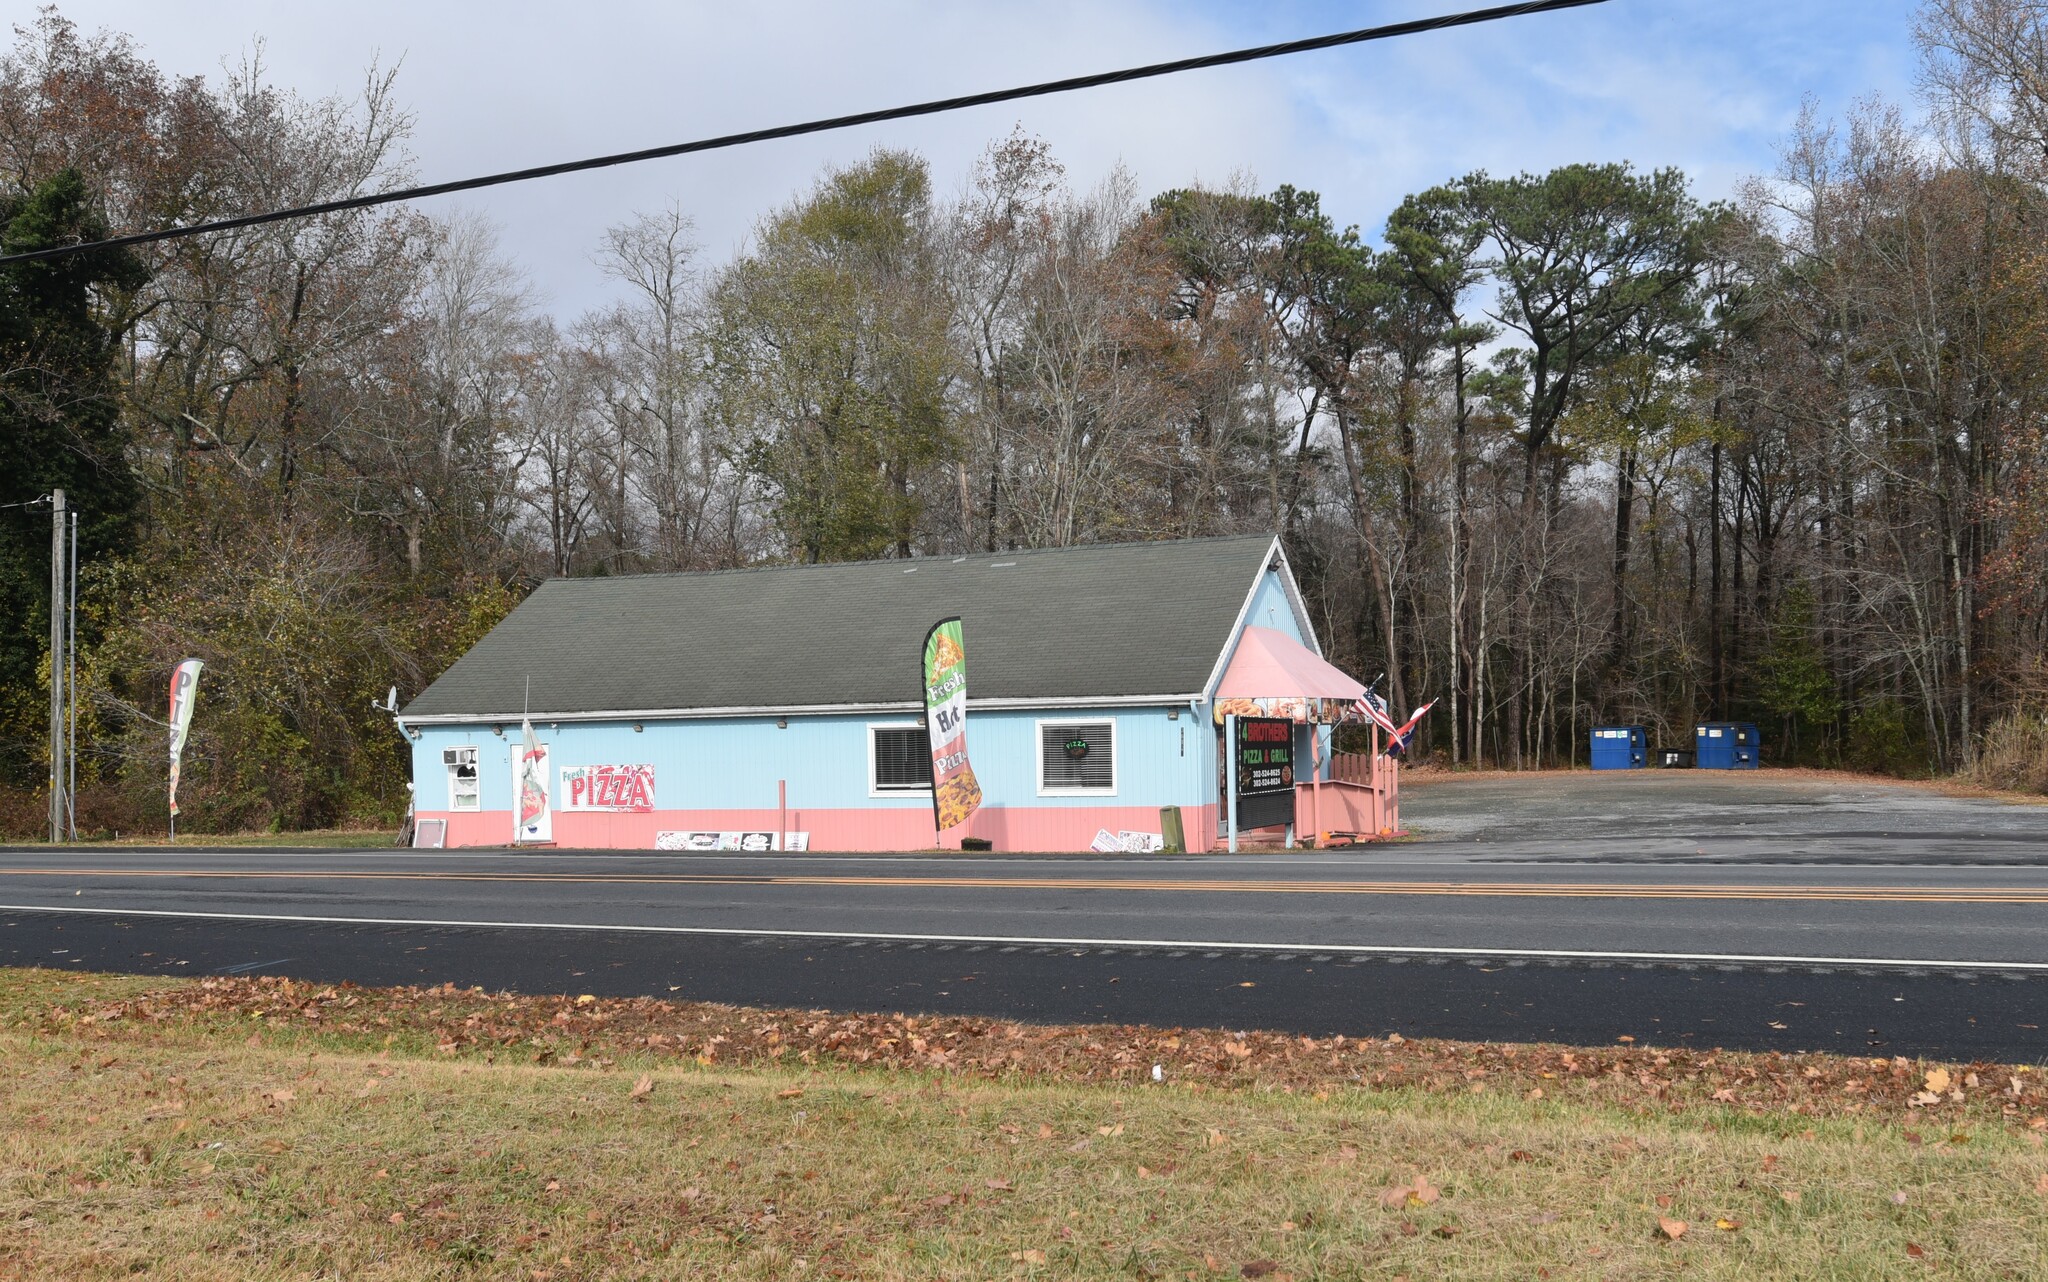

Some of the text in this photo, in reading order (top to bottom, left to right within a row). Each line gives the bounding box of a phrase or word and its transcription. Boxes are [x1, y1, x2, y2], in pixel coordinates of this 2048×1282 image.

[928, 671, 965, 701] Fresh
[1242, 722, 1288, 742] 4 BROTHERS
[1066, 740, 1086, 749] PIZZA
[1243, 748, 1288, 764] PIZZA & GRILL
[563, 768, 585, 782] Fresh
[570, 772, 650, 806] PIZZA
